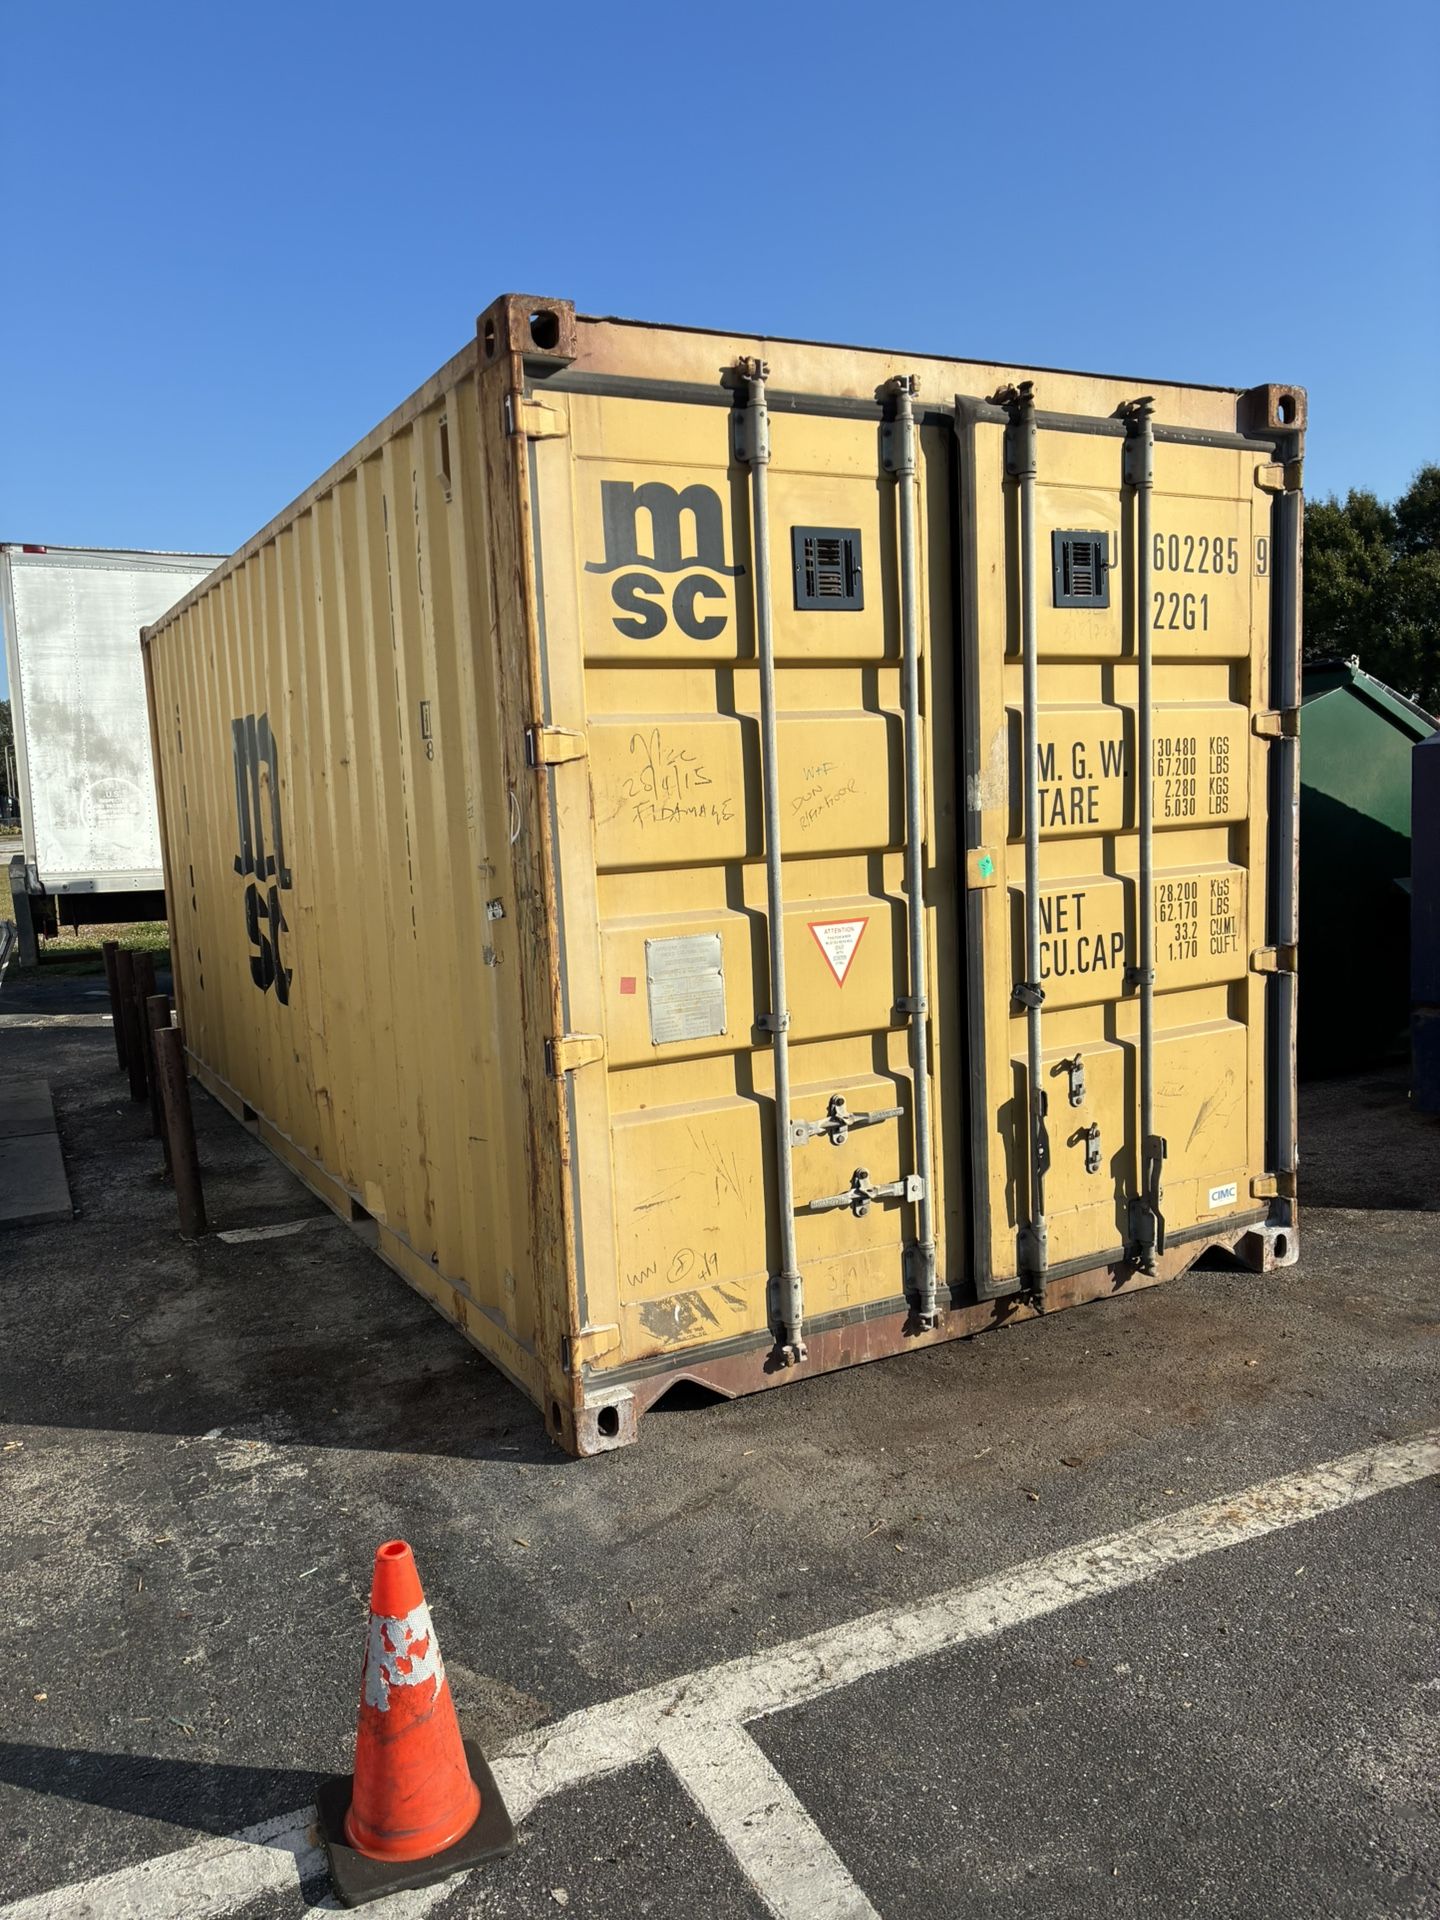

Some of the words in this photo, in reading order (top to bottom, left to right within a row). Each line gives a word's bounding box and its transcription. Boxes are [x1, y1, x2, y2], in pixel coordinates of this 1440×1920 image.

[1153, 533, 1239, 574] 602285
[1256, 538, 1268, 574] 9
[1153, 592, 1209, 631] 22G1
[1158, 737, 1196, 757] 30.480
[1209, 736, 1230, 755] KGS
[1158, 757, 1196, 776] 67.200
[1209, 756, 1229, 774] LBS
[1165, 778, 1196, 798] 2.280
[1209, 776, 1229, 796] KGS
[1038, 785, 1099, 827] TARE
[1165, 797, 1196, 817] 5.030
[1209, 795, 1229, 815] LBS
[1160, 881, 1197, 903] 28.200
[1210, 878, 1230, 897] KGS
[1039, 893, 1086, 935] NET
[1160, 900, 1197, 922] 62.170
[1210, 897, 1229, 916] LBS
[1175, 921, 1197, 941] 33.2
[1169, 940, 1198, 961] 1.170
[1211, 1187, 1236, 1201] CIMC
